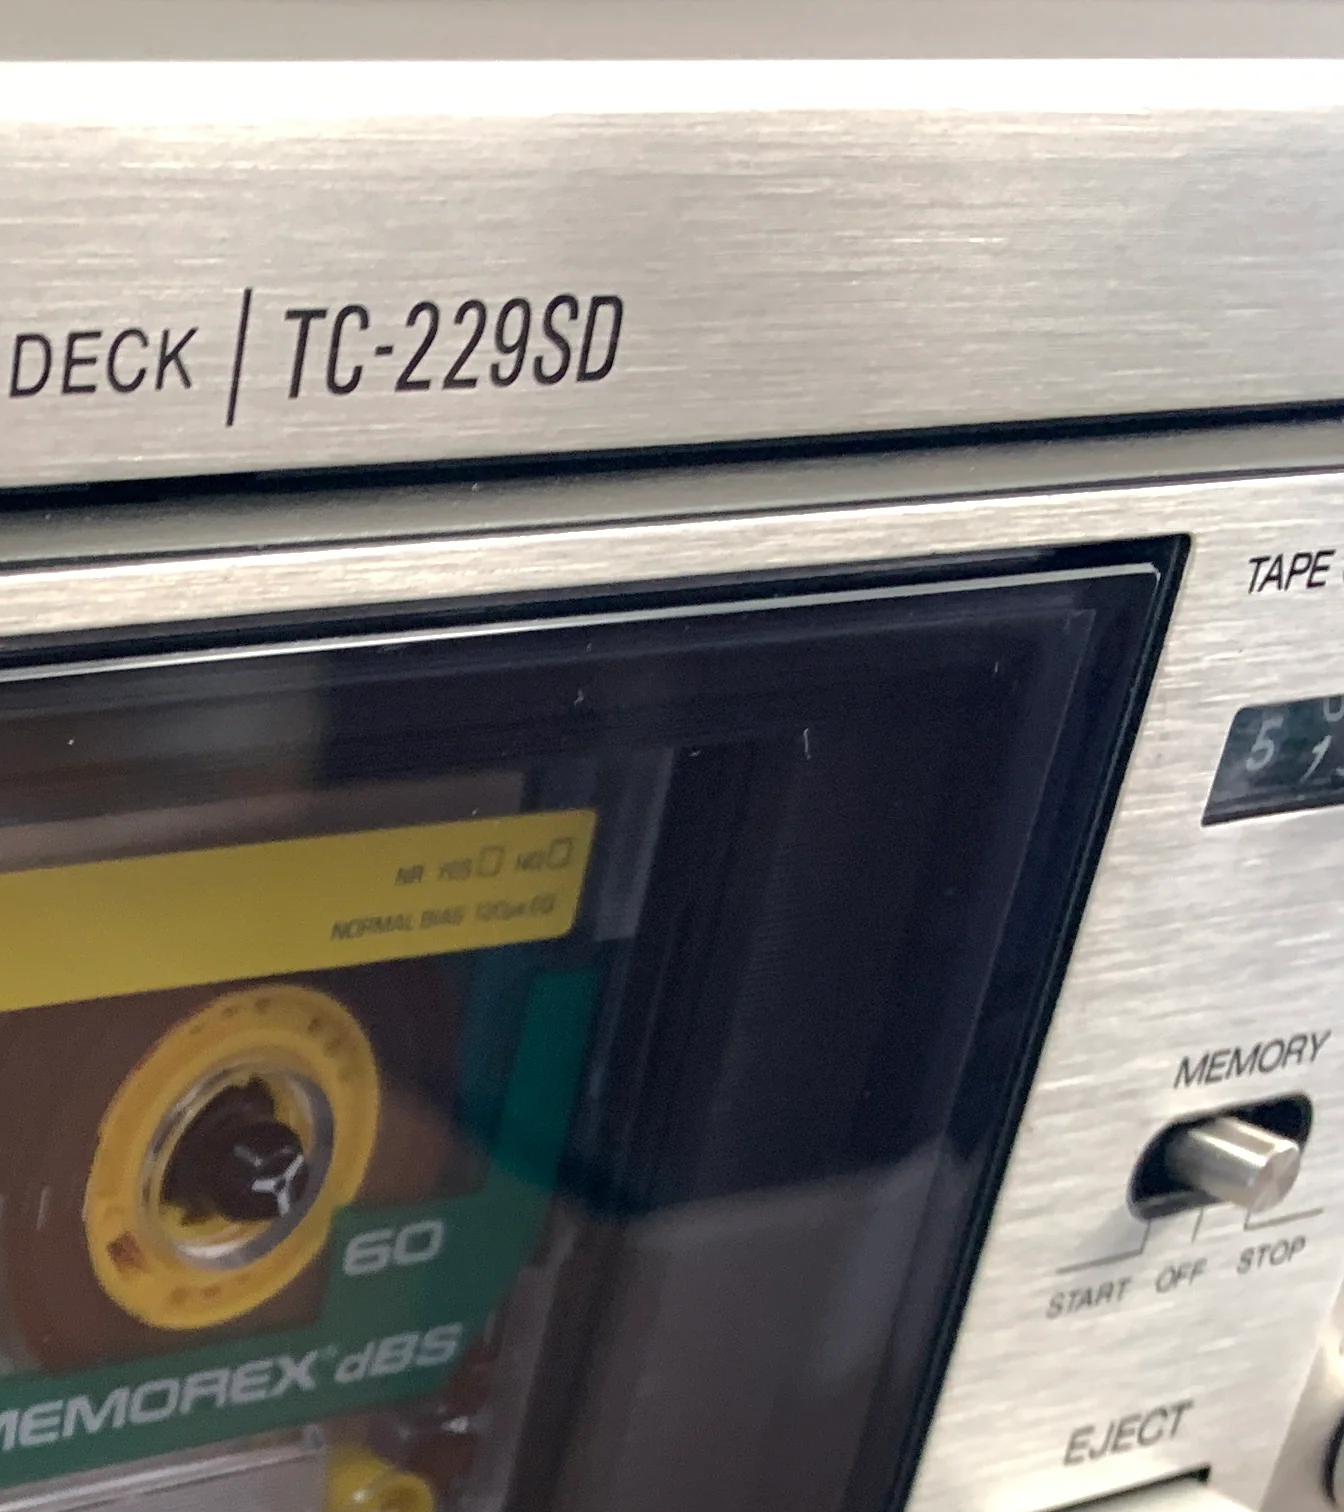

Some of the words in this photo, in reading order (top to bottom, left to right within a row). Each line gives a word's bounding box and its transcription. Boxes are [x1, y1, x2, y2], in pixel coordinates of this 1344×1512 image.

[10, 327, 199, 398] DECK
[284, 293, 624, 399] TC-229SD
[1248, 550, 1336, 595] TAPE
[331, 913, 413, 940] NORMAL
[1174, 1030, 1332, 1090] MEMORY
[342, 1219, 445, 1277] 60
[1045, 1277, 1132, 1319] START
[1155, 1258, 1208, 1294] OFF
[1236, 1235, 1307, 1274] STOP
[333, 1323, 464, 1385] dBS
[1063, 1400, 1194, 1467] EJECT
